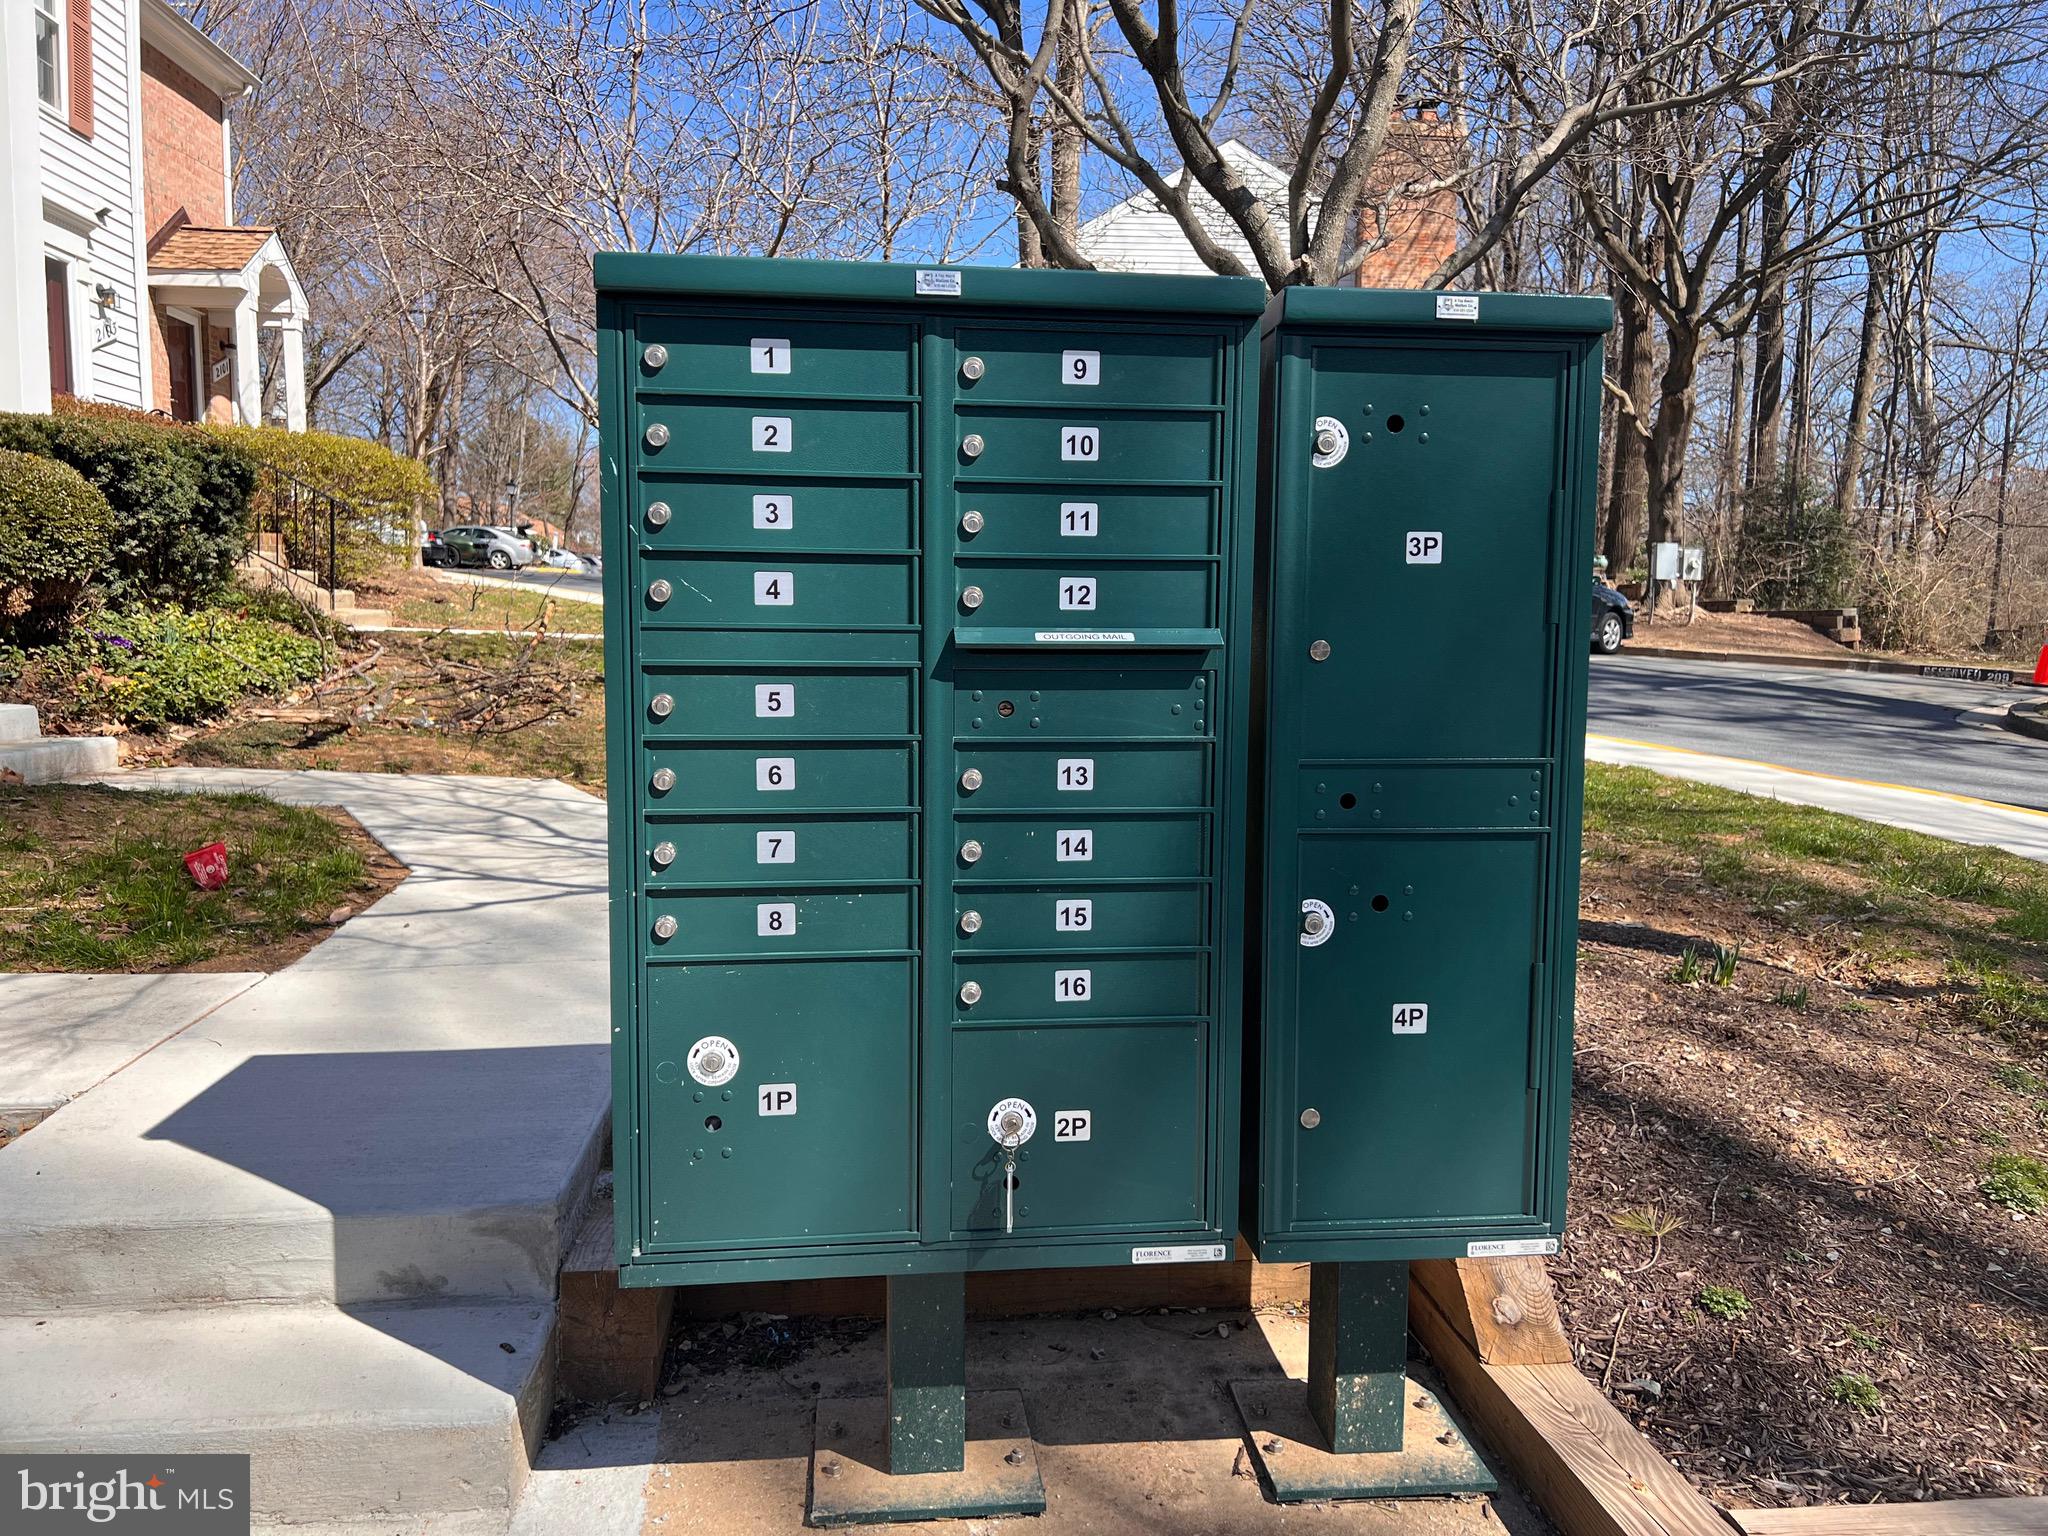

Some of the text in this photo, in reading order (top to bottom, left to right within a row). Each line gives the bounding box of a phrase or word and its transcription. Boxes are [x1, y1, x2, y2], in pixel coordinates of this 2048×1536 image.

[763, 346, 774, 368] 1
[215, 361, 230, 378] 2101
[1073, 358, 1087, 380] 9
[763, 424, 778, 446] 2
[1317, 420, 1338, 429] OPEN
[1066, 434, 1094, 456] 10
[765, 502, 779, 524] 3
[1065, 510, 1090, 531] 11
[1408, 536, 1439, 557] 3P
[765, 579, 781, 600] 4
[1064, 584, 1091, 606] 12
[767, 691, 782, 712] 5
[768, 765, 782, 786] 6
[1062, 765, 1088, 786] 13
[768, 838, 782, 859] 7
[1060, 836, 1088, 857] 14
[1303, 901, 1324, 910] OPEN
[768, 910, 783, 931] 8
[1060, 906, 1087, 927] 15
[1059, 976, 1086, 997] 16
[1394, 1008, 1424, 1027] 4P
[701, 1040, 728, 1050] OPEN
[762, 1091, 793, 1111] 1P
[999, 1101, 1025, 1111] OPEN
[1057, 1117, 1087, 1137] 2P
